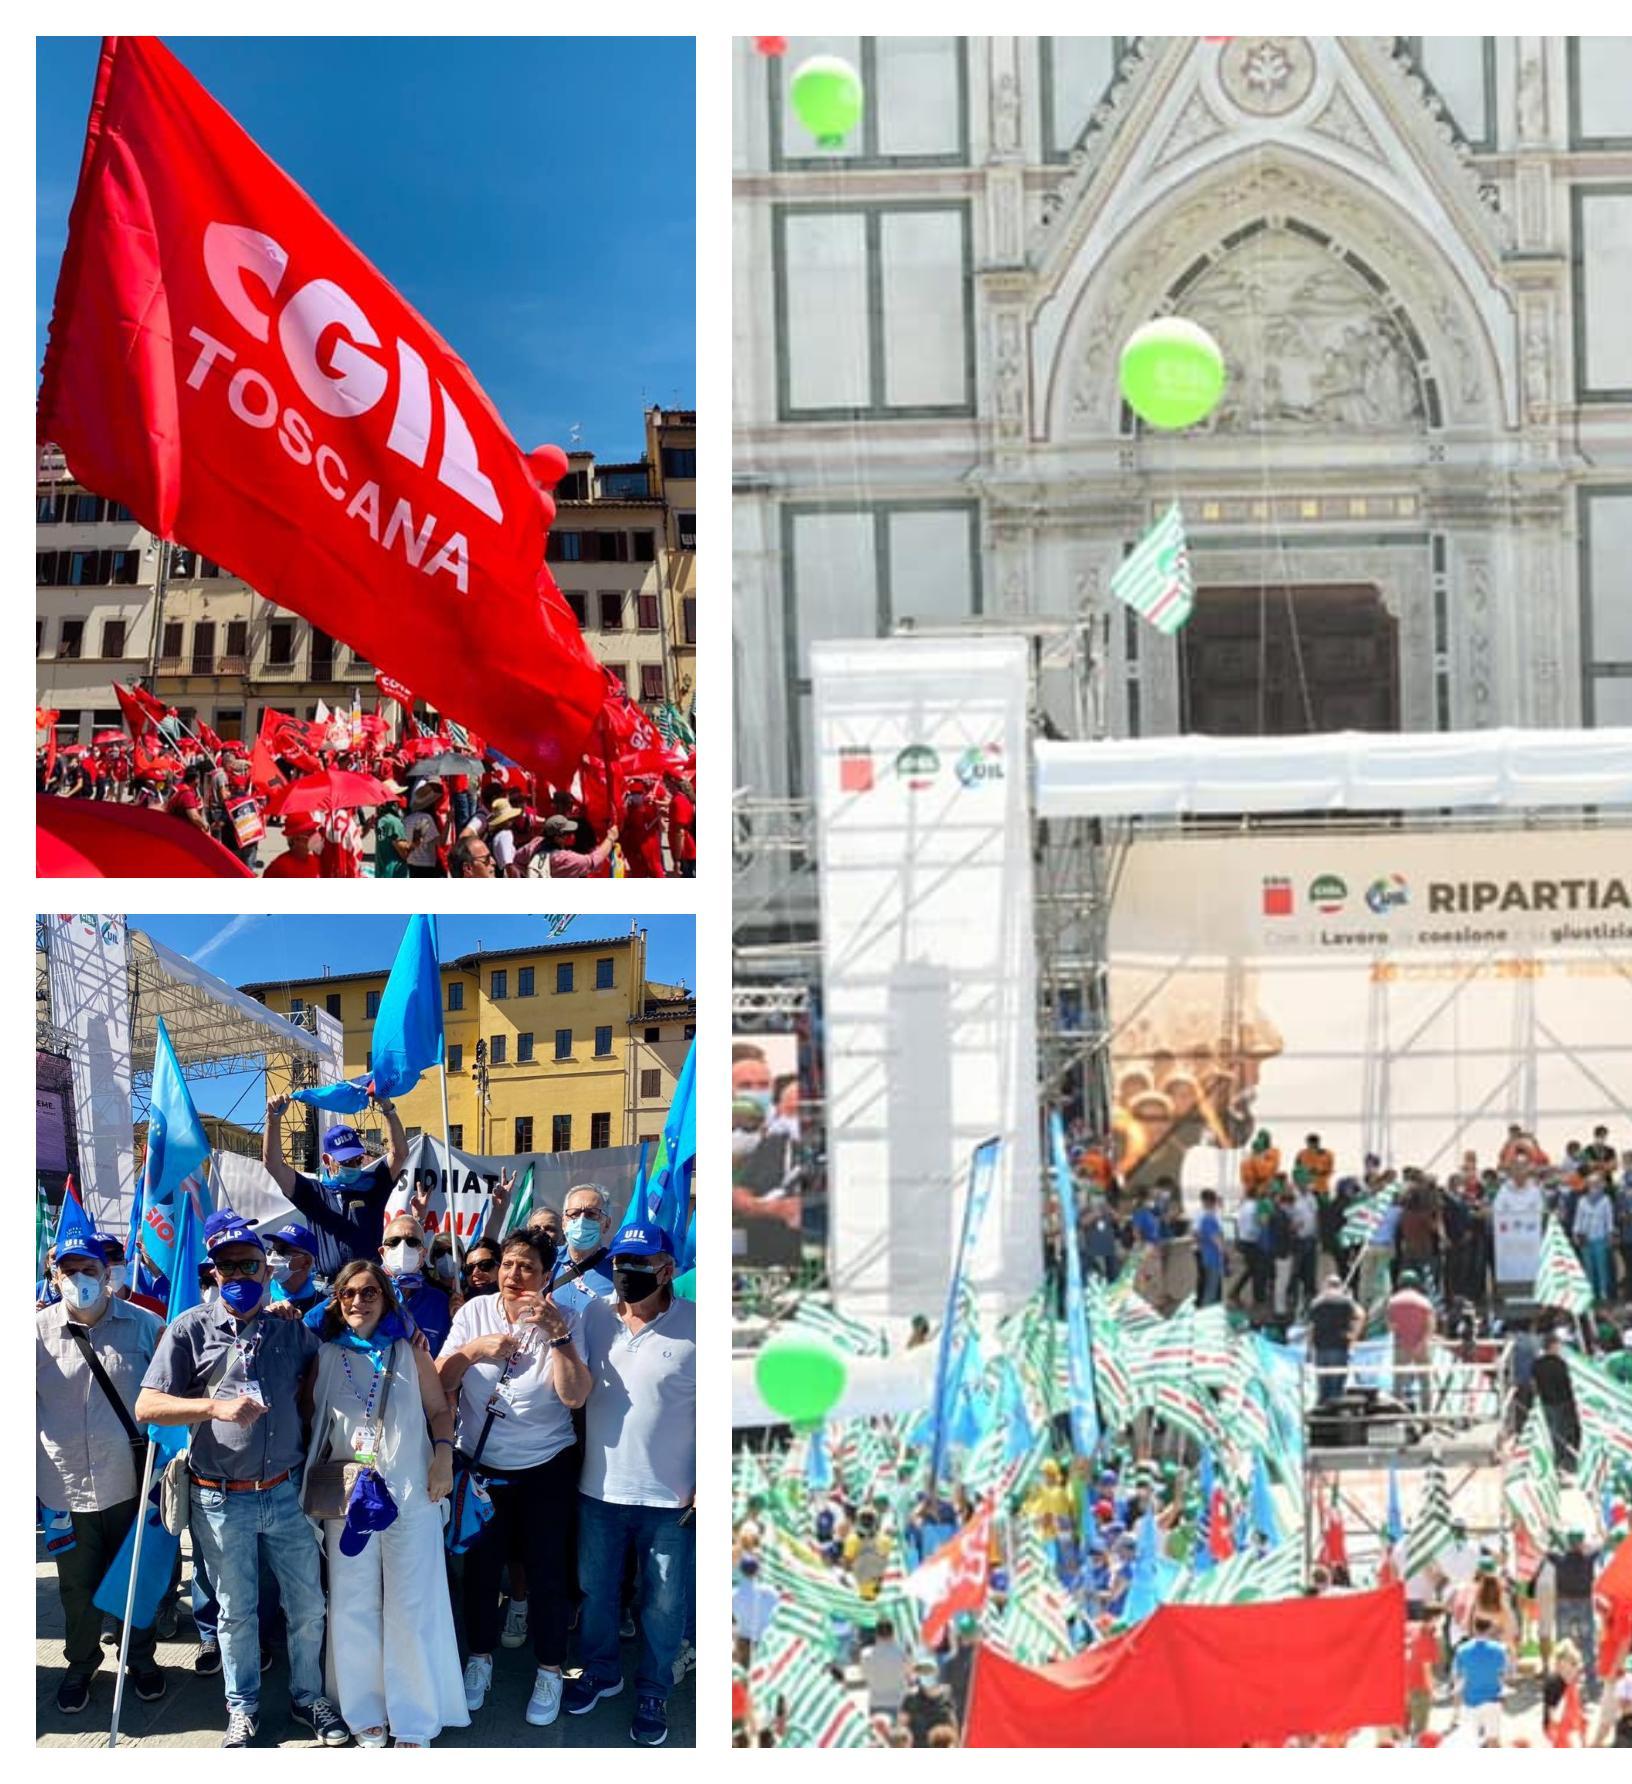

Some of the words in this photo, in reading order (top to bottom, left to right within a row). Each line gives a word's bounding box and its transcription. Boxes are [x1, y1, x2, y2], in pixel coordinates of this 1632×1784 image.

[203, 221, 504, 525] CGIL
[186, 326, 469, 594] TOSCANA
[1321, 929, 1388, 946] Lavoro
[1418, 926, 1507, 944] coesione
[334, 1133, 354, 1146] UILP
[624, 1229, 645, 1239] UIL
[64, 1238, 85, 1247] UIL
